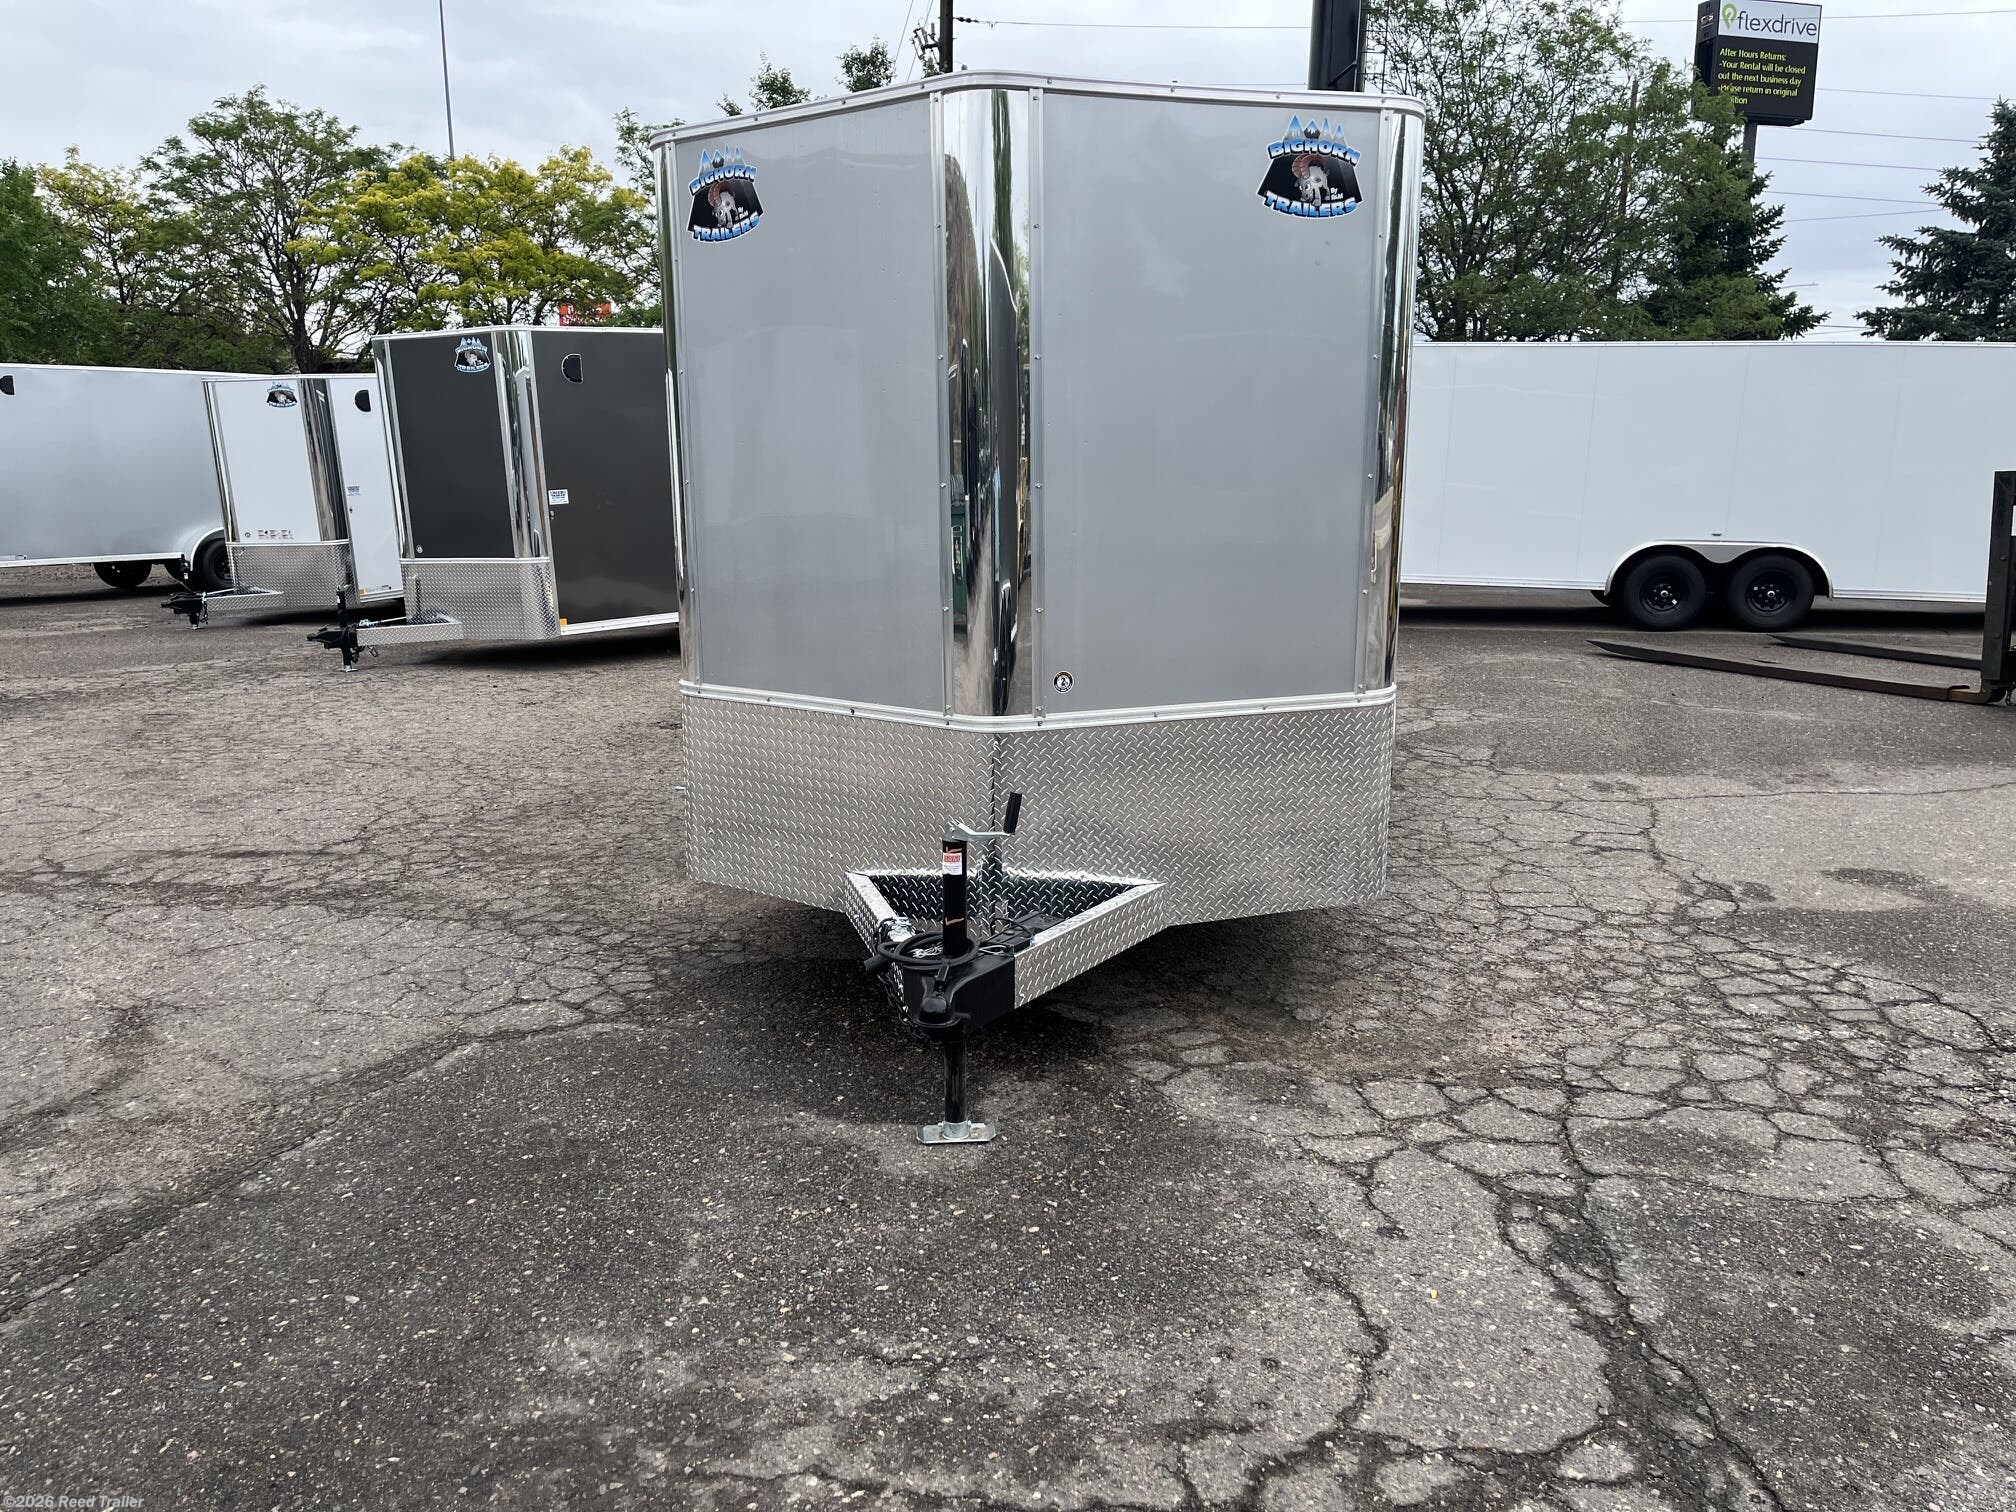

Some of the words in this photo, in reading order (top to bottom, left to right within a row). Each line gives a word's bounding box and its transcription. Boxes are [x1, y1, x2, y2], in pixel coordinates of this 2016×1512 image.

[1737, 11, 1817, 36] flexdrive
[1719, 48, 1738, 57] After
[1738, 49, 1759, 59] Hours
[1760, 51, 1787, 61] Returns:
[1717, 72, 1730, 80] out
[1731, 72, 1743, 81] the
[1744, 74, 1759, 82] next
[1760, 74, 1788, 85] business
[1789, 76, 1802, 88] day
[1740, 61, 1761, 71] Rental
[1762, 63, 1774, 72] will
[1775, 63, 1784, 73] be
[1785, 65, 1806, 75] closed
[1743, 86, 1764, 94] return
[1764, 87, 1772, 95] in
[1773, 88, 1798, 98] original
[1267, 139, 1360, 167] BIGHORN
[690, 165, 757, 196] BIGHORN
[1264, 190, 1358, 218] TRAILERS
[693, 211, 760, 242] TRAILERS
